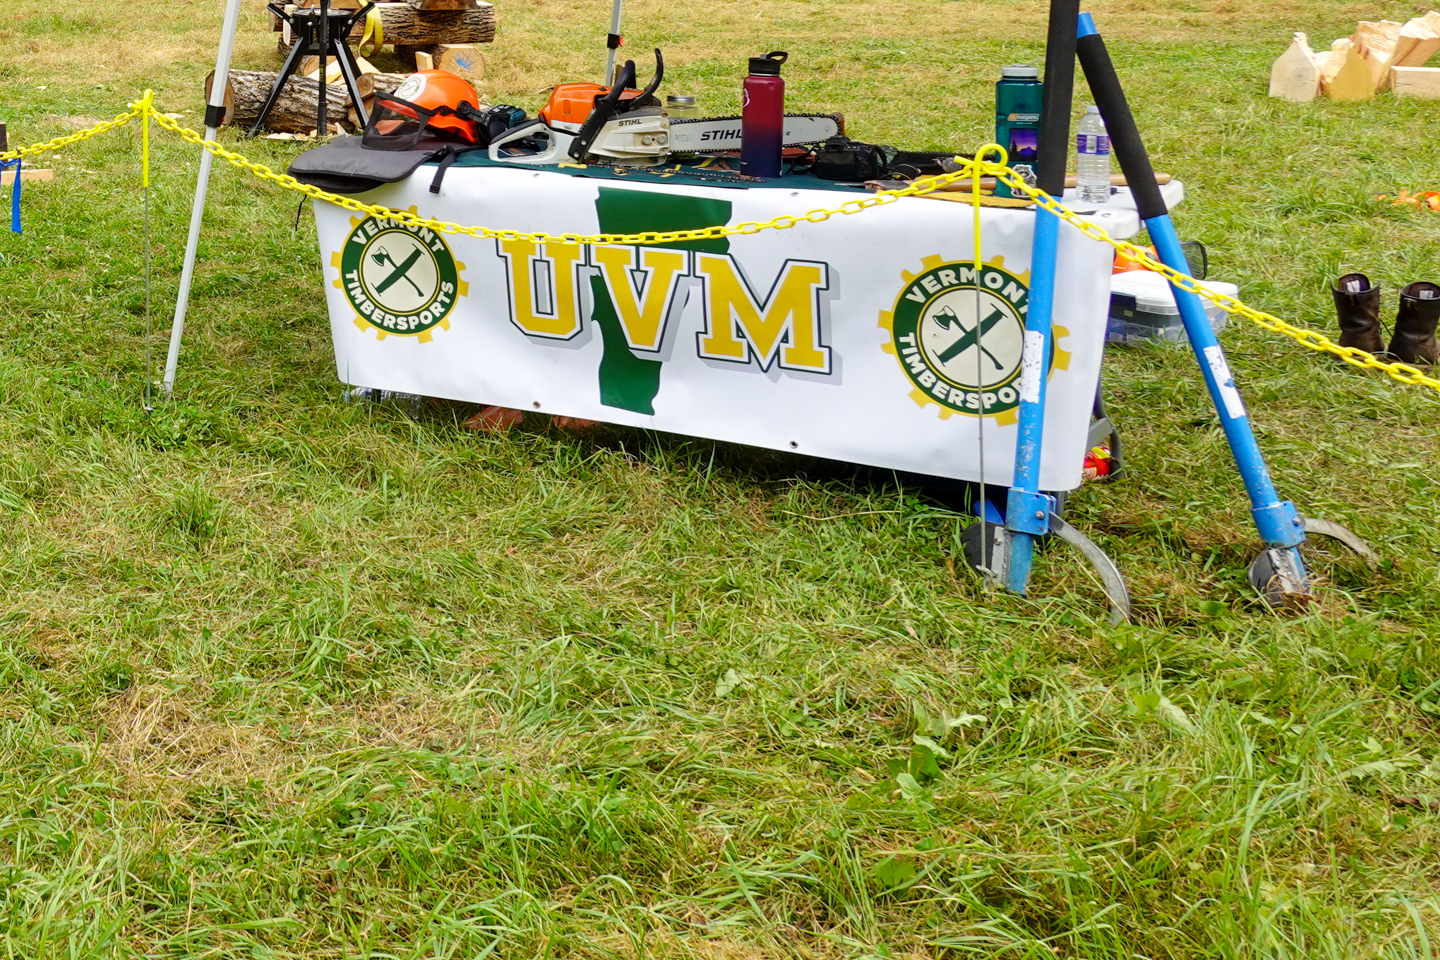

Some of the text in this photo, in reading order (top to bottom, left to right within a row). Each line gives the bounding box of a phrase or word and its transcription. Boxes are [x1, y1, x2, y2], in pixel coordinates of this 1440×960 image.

[618, 118, 642, 127] STIHL
[700, 129, 742, 141] STIHL
[352, 216, 445, 252] VERMONT
[345, 269, 455, 331] TIMBERSPORTS
[496, 236, 832, 375] UVM
[899, 332, 1023, 409] TIMBERSPO
